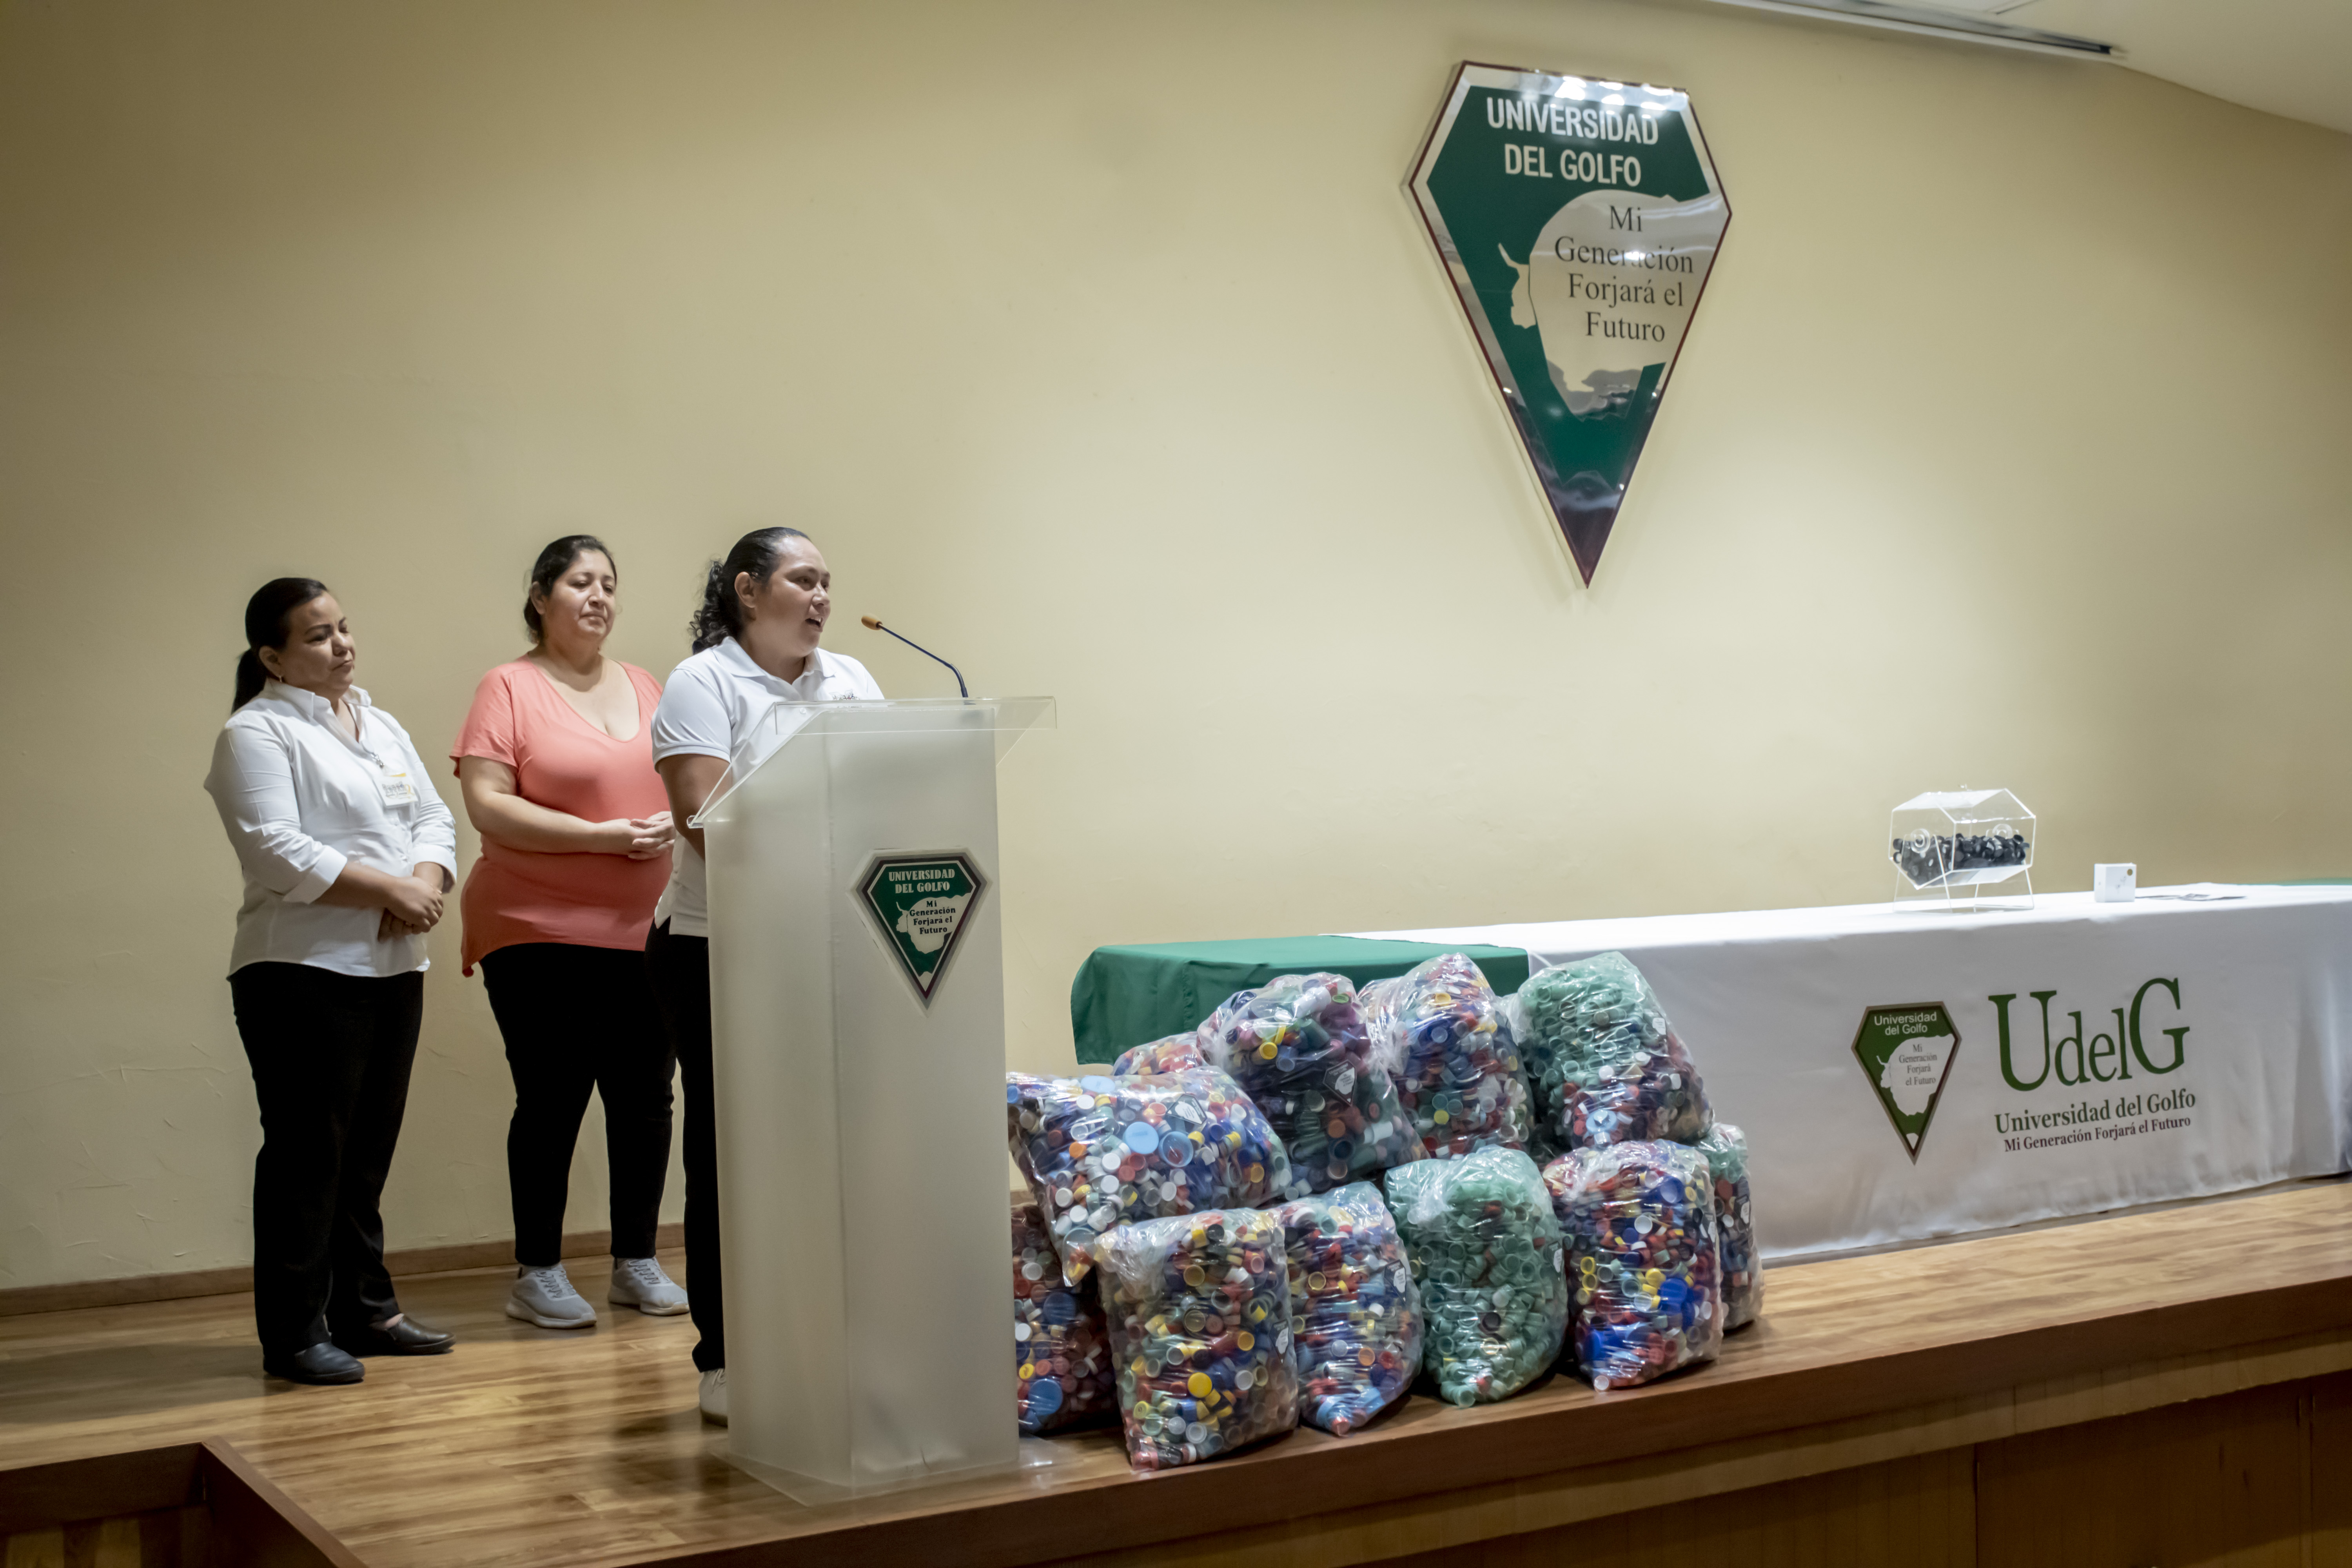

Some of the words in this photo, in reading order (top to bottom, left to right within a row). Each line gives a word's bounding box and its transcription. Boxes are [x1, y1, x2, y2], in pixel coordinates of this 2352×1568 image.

[1486, 97, 1659, 145] UNIVERSIDAD
[1504, 143, 1553, 178] DEL
[1560, 149, 1641, 187] GOLFO
[1609, 205, 1642, 232] Mi
[1568, 272, 1655, 308] Forjará
[1664, 282, 1684, 307] el
[1586, 311, 1665, 343] Futuro
[889, 869, 955, 881] UNIVERSIDAD
[895, 884, 914, 894] DEL
[917, 882, 950, 892] GOLFO
[909, 907, 956, 916] Generación
[913, 916, 942, 926] Forjará
[1874, 1011, 1937, 1026] Universidad
[1884, 1025, 1900, 1036] del
[1902, 1023, 1928, 1034] Golfo
[1988, 977, 2190, 1092] UdelG
[1913, 1044, 1922, 1053] Mi
[1899, 1053, 1937, 1063] Generación
[1907, 1063, 1931, 1075] Forjará
[1906, 1077, 1911, 1086] el
[1914, 1076, 1936, 1085] Futuro
[1994, 1099, 2111, 1134] Universidad
[2115, 1094, 2142, 1118] del
[2147, 1088, 2196, 1113] Golfo
[2004, 1137, 2020, 1152] Mi
[2024, 1129, 2092, 1150] Generación
[2095, 1122, 2136, 1141] Forjará
[2139, 1120, 2148, 1133] el
[2151, 1117, 2191, 1132] Futuro
